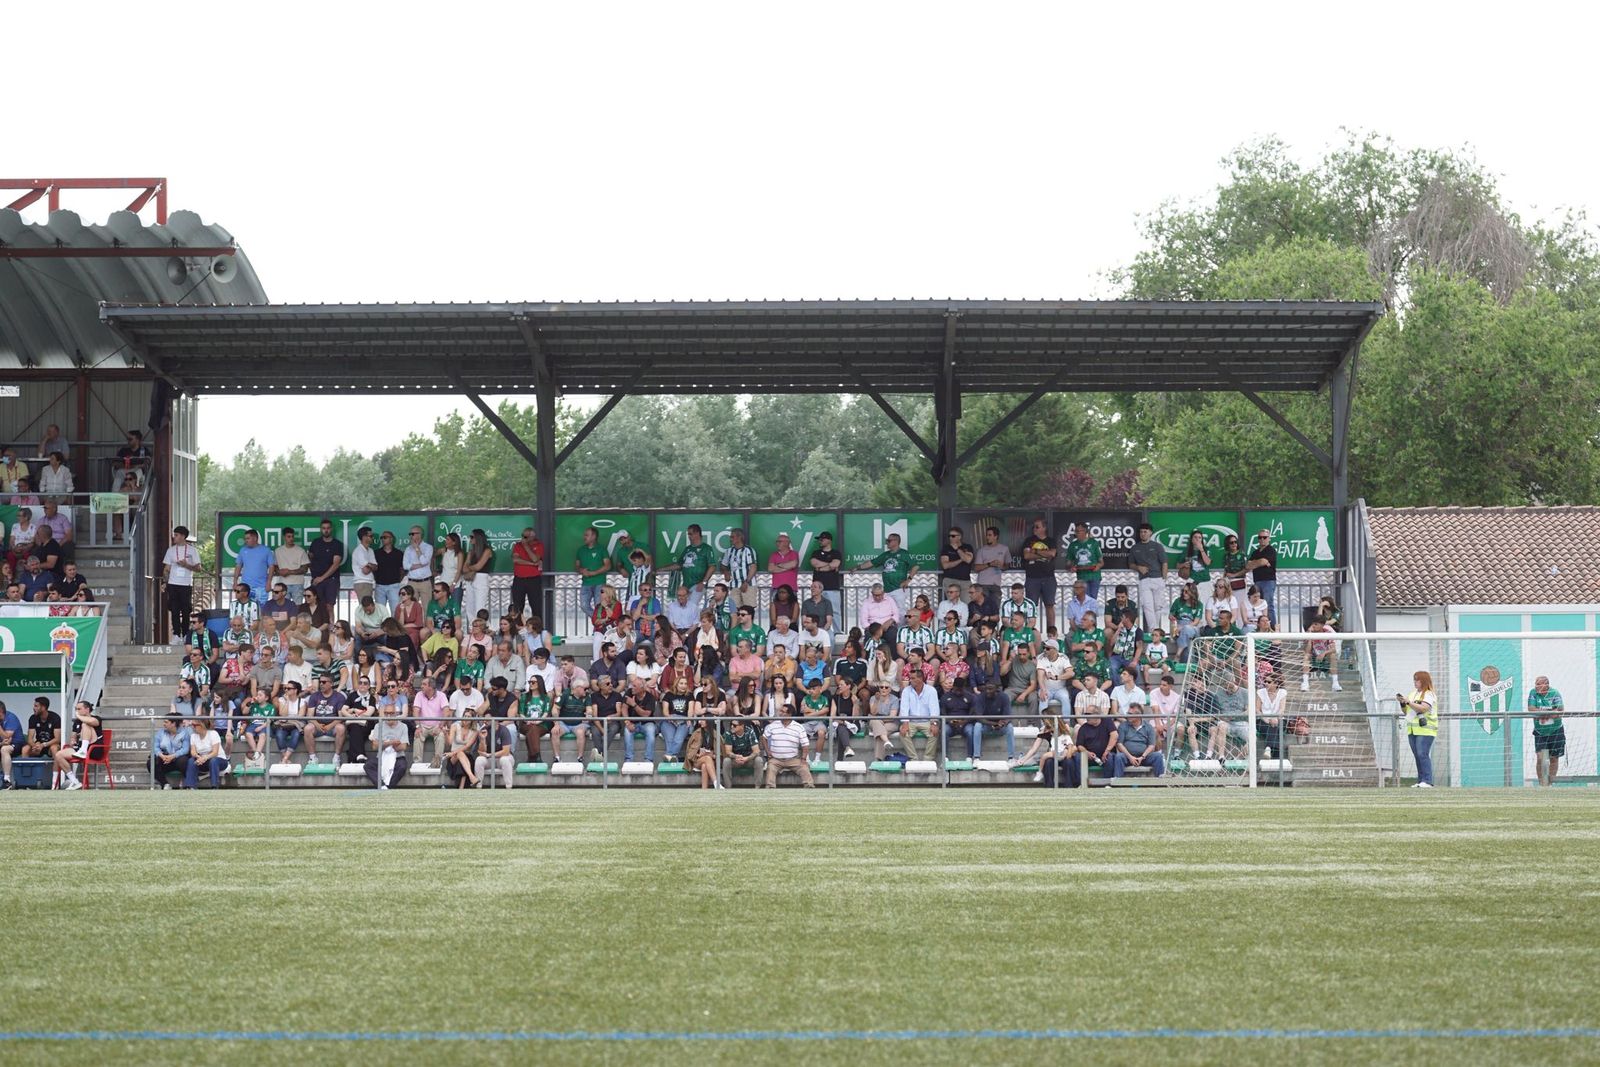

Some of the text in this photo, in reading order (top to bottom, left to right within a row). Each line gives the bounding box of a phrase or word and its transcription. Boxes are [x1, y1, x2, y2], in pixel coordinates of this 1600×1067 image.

[1269, 519, 1283, 538] LA
[1246, 534, 1310, 559] RGENTA
[95, 560, 124, 568] FILA 4
[91, 588, 116, 596] ILA 3
[142, 646, 172, 654] FILA 5
[6, 679, 57, 688] LA GACETA
[131, 677, 162, 685] FILA 4
[1307, 703, 1338, 711] FILA 3
[124, 708, 155, 716] FILA 3
[1315, 735, 1347, 744] FILA 2
[116, 741, 147, 749] FILA 2
[1322, 769, 1353, 777] FILA 1
[104, 775, 127, 783] FILA
